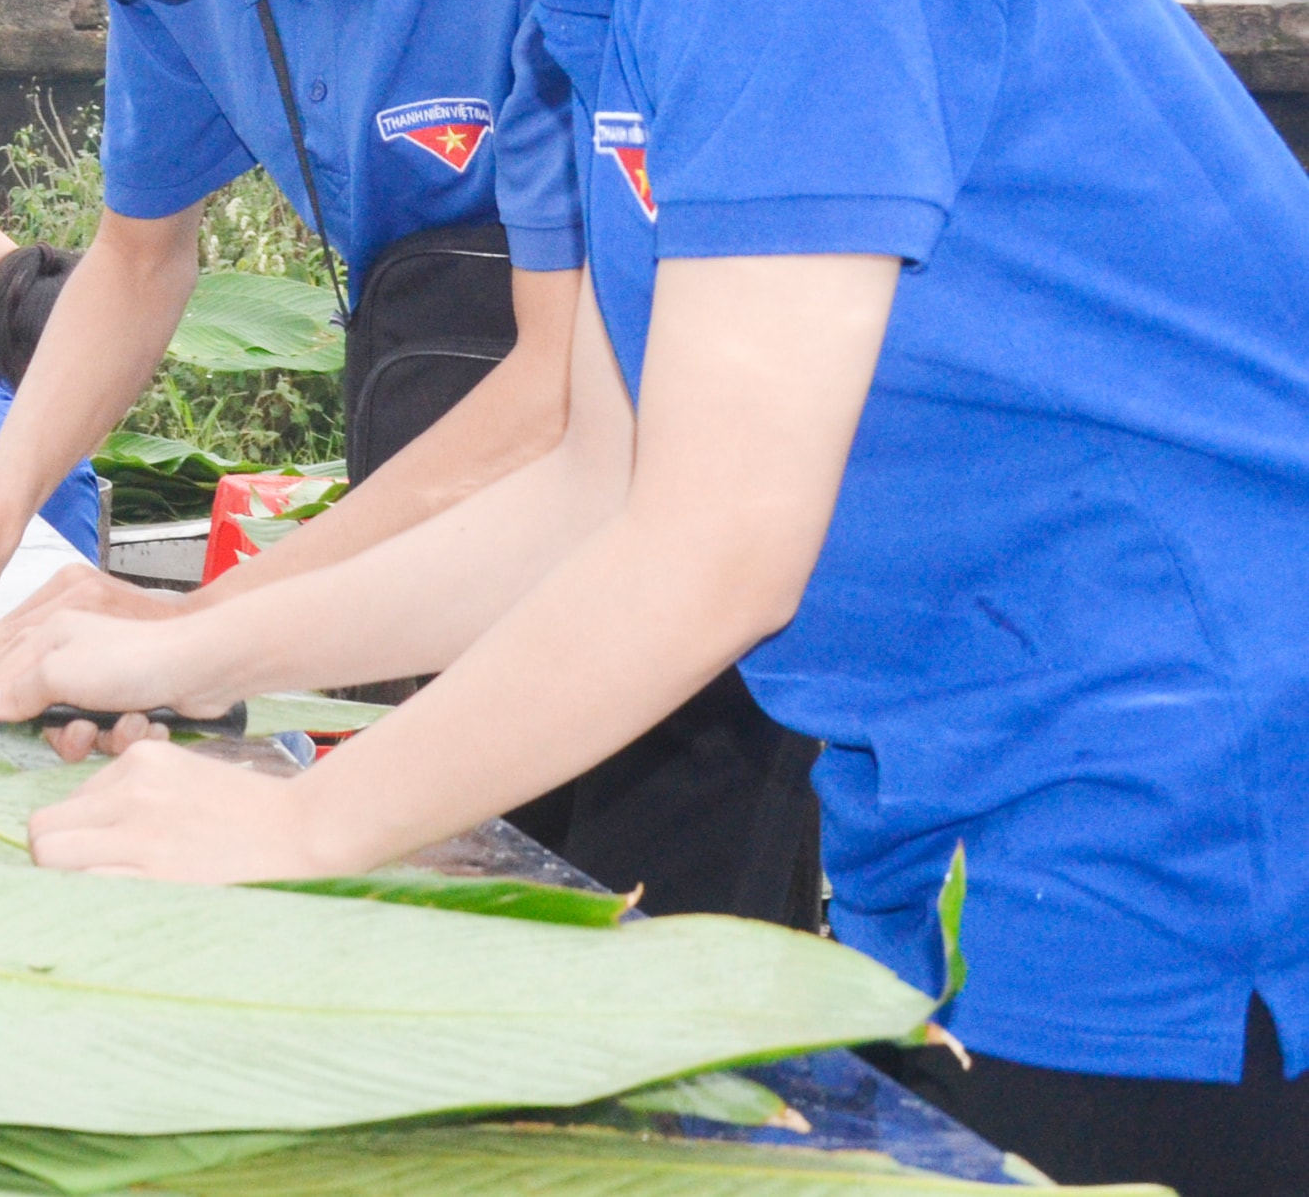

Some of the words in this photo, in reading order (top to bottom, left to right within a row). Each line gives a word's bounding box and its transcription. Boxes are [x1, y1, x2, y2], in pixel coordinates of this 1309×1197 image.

[382, 112, 424, 131] THANH
[424, 104, 451, 121] NIÊN
[450, 103, 475, 121] VIỆT
